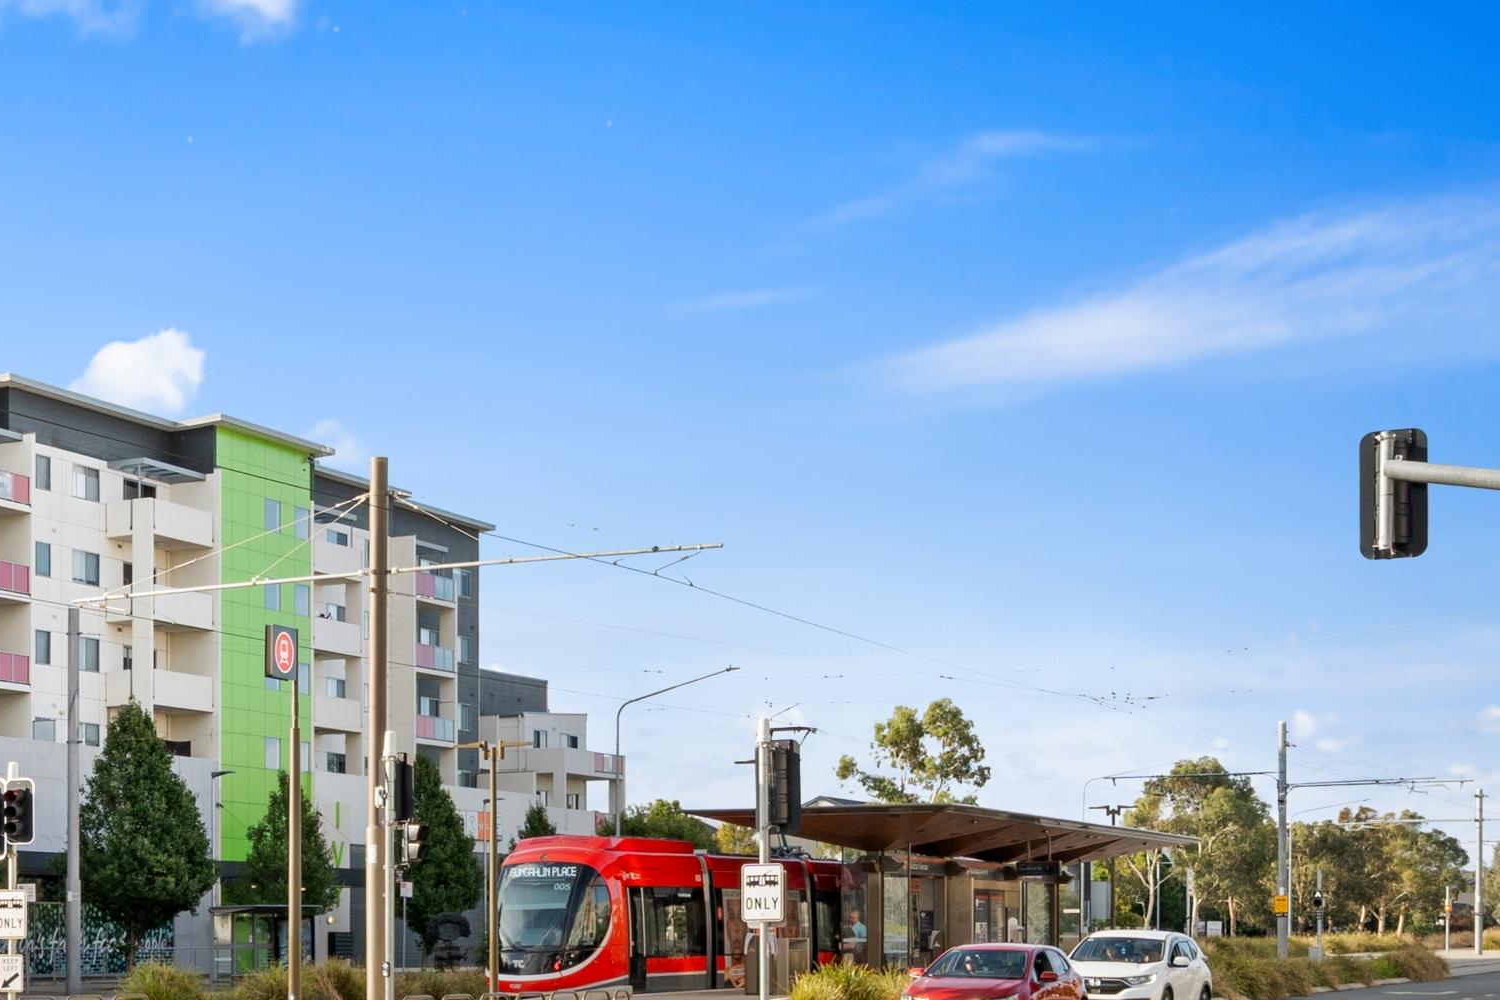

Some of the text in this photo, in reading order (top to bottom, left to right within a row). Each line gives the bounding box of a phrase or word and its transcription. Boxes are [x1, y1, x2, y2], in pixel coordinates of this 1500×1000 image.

[552, 866, 577, 877] PLACE
[554, 883, 571, 891] 005
[746, 897, 779, 910] ONLY
